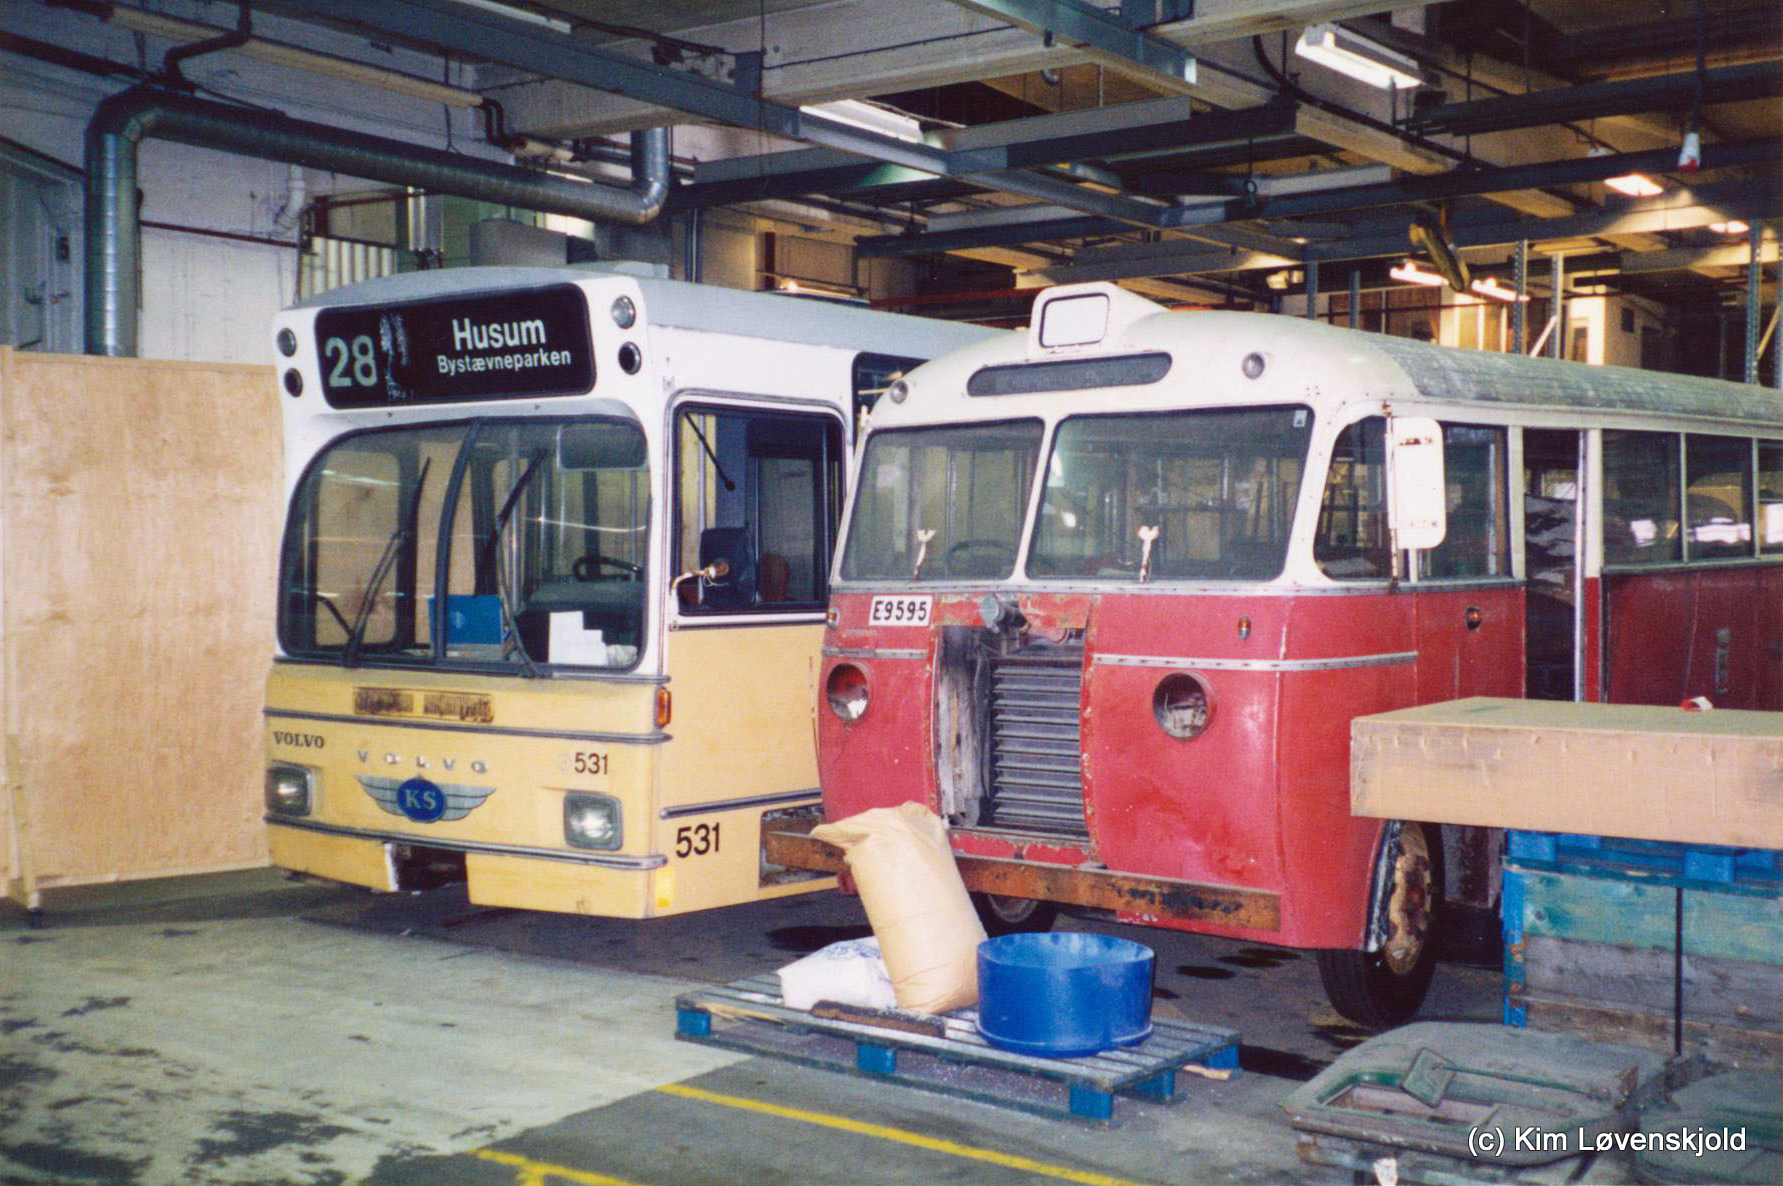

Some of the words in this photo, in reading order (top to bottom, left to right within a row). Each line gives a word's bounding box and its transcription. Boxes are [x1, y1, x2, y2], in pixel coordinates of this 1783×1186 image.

[452, 319, 546, 351] Husum
[324, 335, 378, 388] 28
[437, 347, 572, 374] Bystævneparken
[872, 600, 928, 621] E9595
[274, 731, 325, 749] VOLVO
[574, 752, 609, 775] 531
[405, 788, 436, 811] KS
[675, 822, 721, 859] 531
